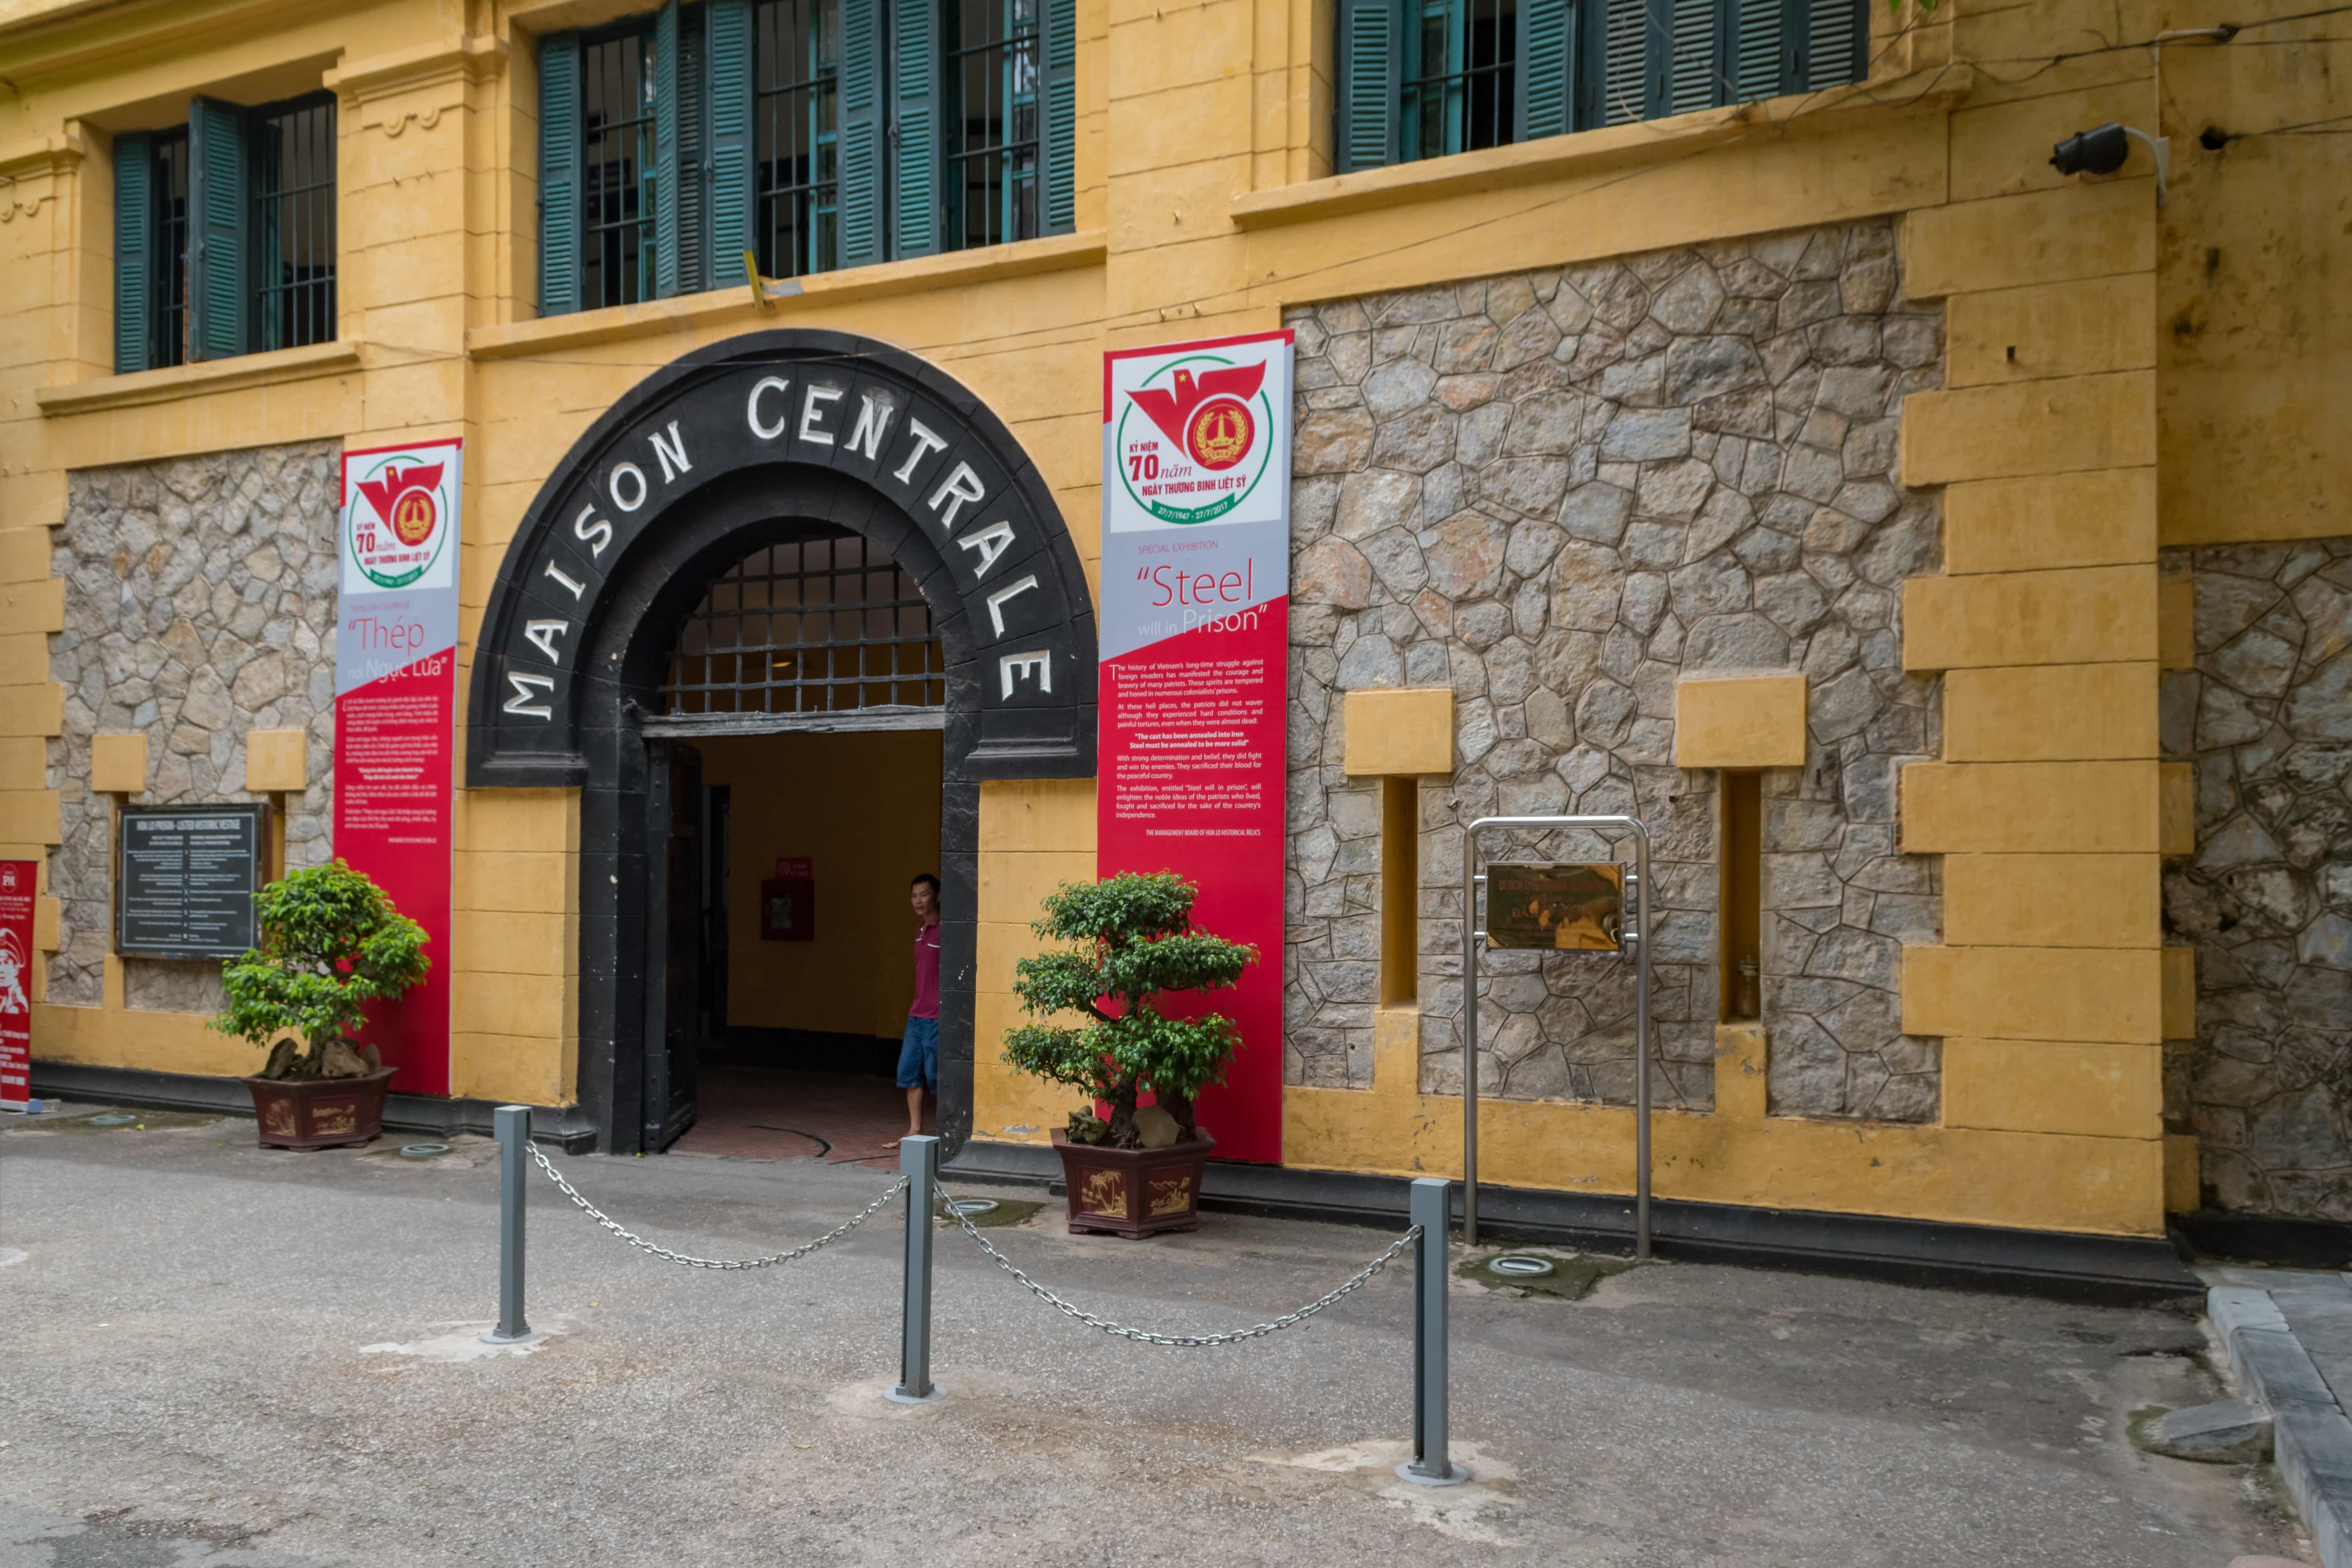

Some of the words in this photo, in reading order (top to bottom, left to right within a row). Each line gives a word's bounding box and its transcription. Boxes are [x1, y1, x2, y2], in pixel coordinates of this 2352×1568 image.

[1140, 440, 1158, 453] NIỆM
[1129, 454, 1159, 481] 70
[1160, 463, 1192, 479] năm
[1142, 483, 1162, 496] NGÀY
[1165, 481, 1194, 495] THƯƠNG
[1197, 479, 1216, 491] BINH
[1218, 475, 1234, 491] LIỆT
[1158, 506, 1190, 520] 27/7/1947
[1196, 501, 1228, 520] 27/7/2017
[356, 533, 375, 554] 70
[503, 420, 693, 721] MAISON
[747, 376, 1051, 701] CENTRALE
[1138, 544, 1170, 555] SPECIAL
[1172, 540, 1218, 552] EXHIBITION
[1138, 621, 1160, 635] will
[1165, 621, 1177, 634] in
[1128, 664, 1147, 672] history
[1186, 661, 1214, 670] long-time
[1216, 659, 1240, 668] struggle
[1242, 659, 1263, 667] against
[1118, 672, 1138, 681] foreign
[1179, 670, 1210, 678] manifested
[1118, 682, 1138, 690] bravery
[1235, 677, 1263, 685] tempered
[1117, 712, 1142, 720] although
[1162, 710, 1196, 719] experienced
[1248, 752, 1261, 760] fight
[1177, 762, 1190, 771] They
[1127, 772, 1150, 780] peaceful
[1116, 802, 1134, 811] fought
